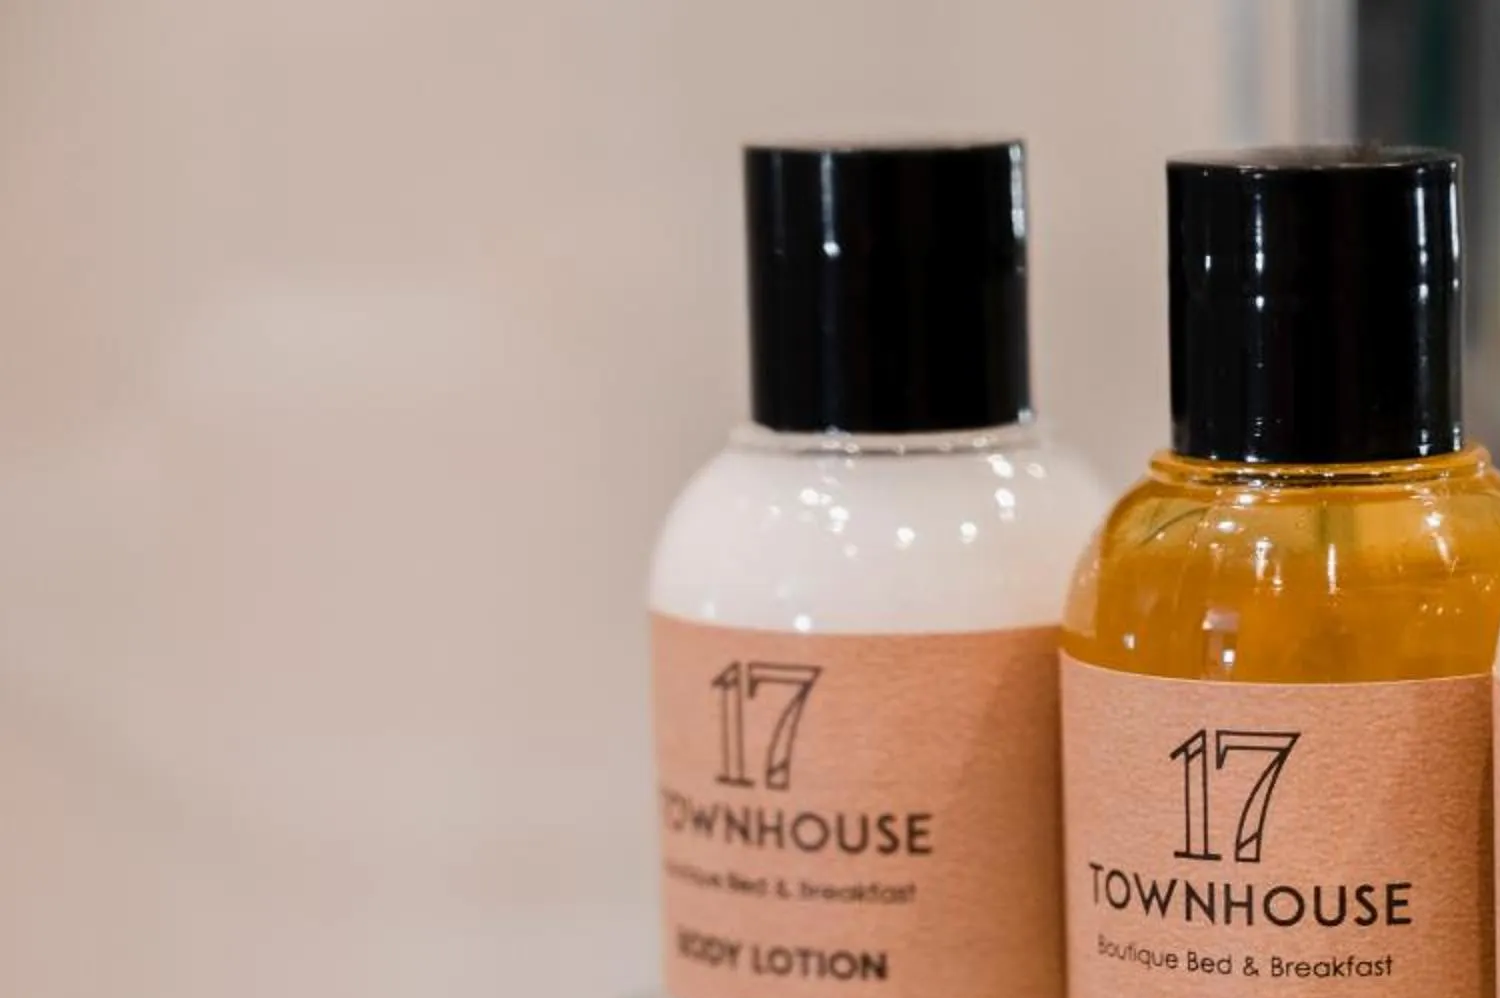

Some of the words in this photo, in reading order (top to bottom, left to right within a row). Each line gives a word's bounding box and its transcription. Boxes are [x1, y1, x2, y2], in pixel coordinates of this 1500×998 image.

[711, 661, 824, 791] 17
[1169, 729, 1301, 863] 17
[1089, 862, 1413, 927] TOWNHOUSE
[752, 944, 888, 982] LOTION
[1098, 934, 1179, 970] Boutique
[1187, 952, 1233, 976] Bed
[1243, 958, 1260, 977] &
[1271, 954, 1394, 979] Breakfast
